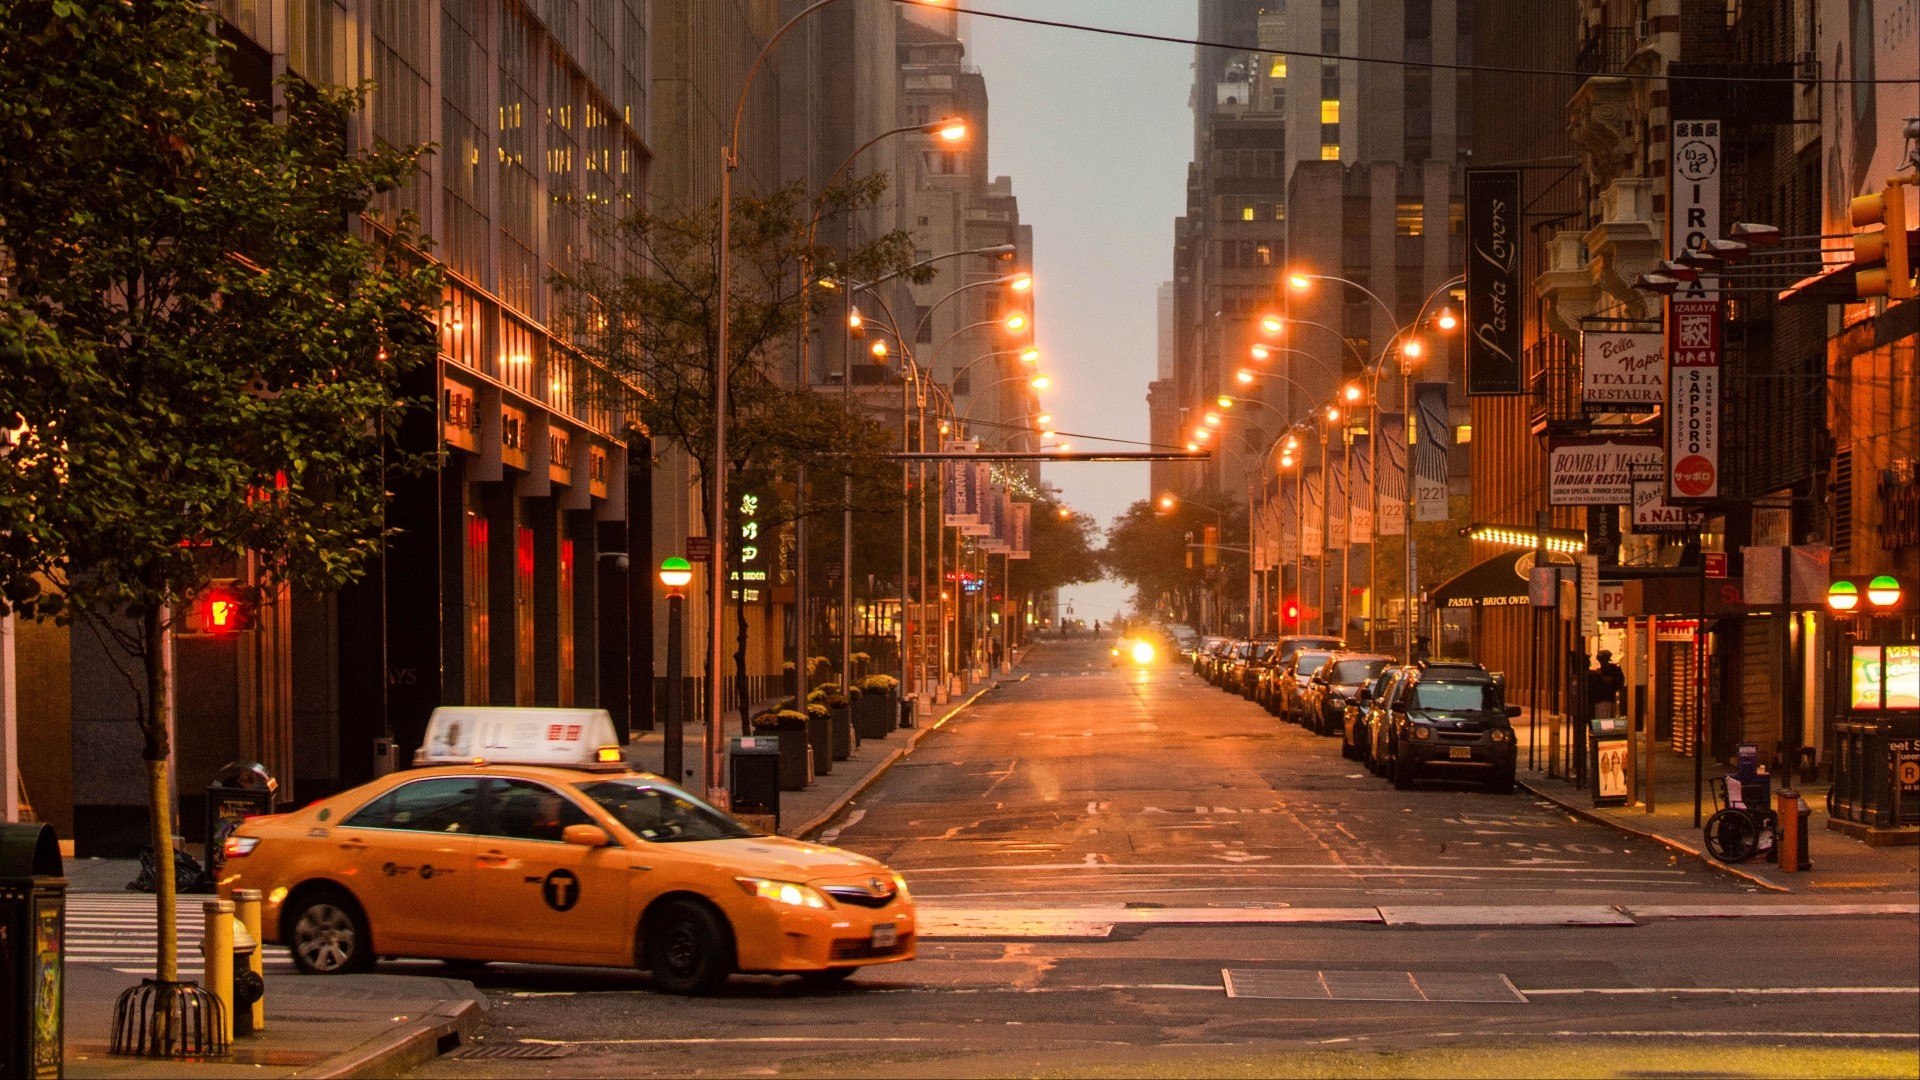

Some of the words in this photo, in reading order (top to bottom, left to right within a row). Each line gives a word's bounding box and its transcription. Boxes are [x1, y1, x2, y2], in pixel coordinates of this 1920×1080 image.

[1474, 199, 1516, 275] Lovers
[1686, 184, 1707, 299] IROA
[1674, 304, 1717, 313] IZAKAYA
[1472, 280, 1514, 363] Pasta
[1599, 338, 1636, 359] Bella
[1592, 374, 1663, 385] ITALIA
[1587, 389, 1663, 400] RESTAURA
[1705, 375, 1713, 408] RAMEN
[1688, 370, 1701, 454] SAPPORO
[1705, 410, 1713, 449] NOODLE
[1554, 453, 1612, 472] BOMBAY
[1553, 474, 1593, 486] INDIAN
[1674, 472, 1711, 482] サッポロ
[1418, 487, 1444, 500] 1221
[1639, 512, 1647, 522] &
[1448, 598, 1474, 607] PASTA
[1482, 596, 1507, 606] BRICK
[1904, 767, 1915, 779] R
[549, 877, 574, 906] T
